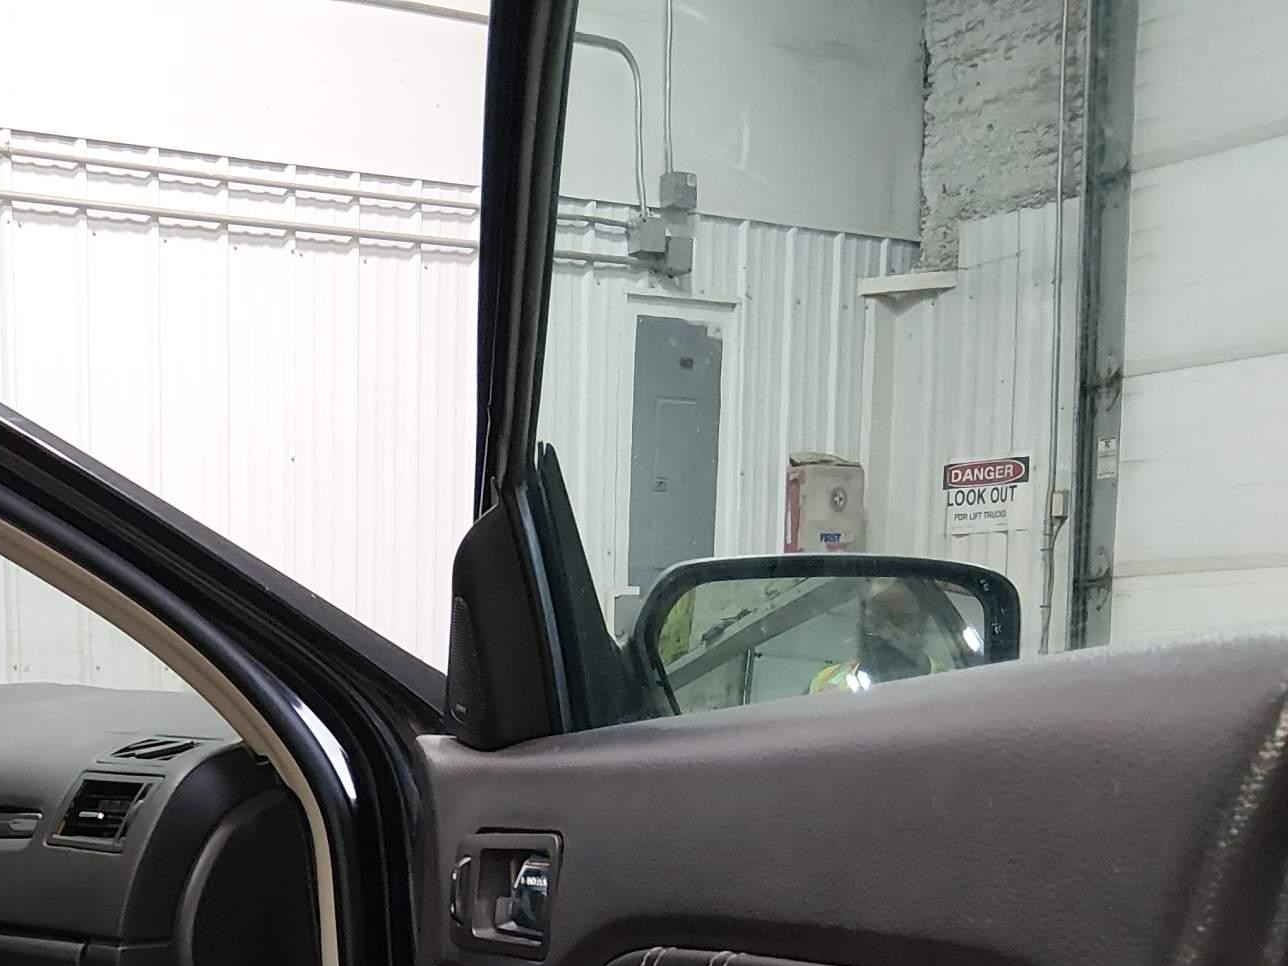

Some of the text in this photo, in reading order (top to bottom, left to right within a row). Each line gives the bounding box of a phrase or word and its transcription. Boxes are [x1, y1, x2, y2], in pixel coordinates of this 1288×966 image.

[951, 464, 1014, 483] DANGER
[947, 485, 1018, 507] LOOK OUT
[954, 510, 1007, 521] FOR LIFT TRUCKS
[820, 533, 842, 543] FIRST
